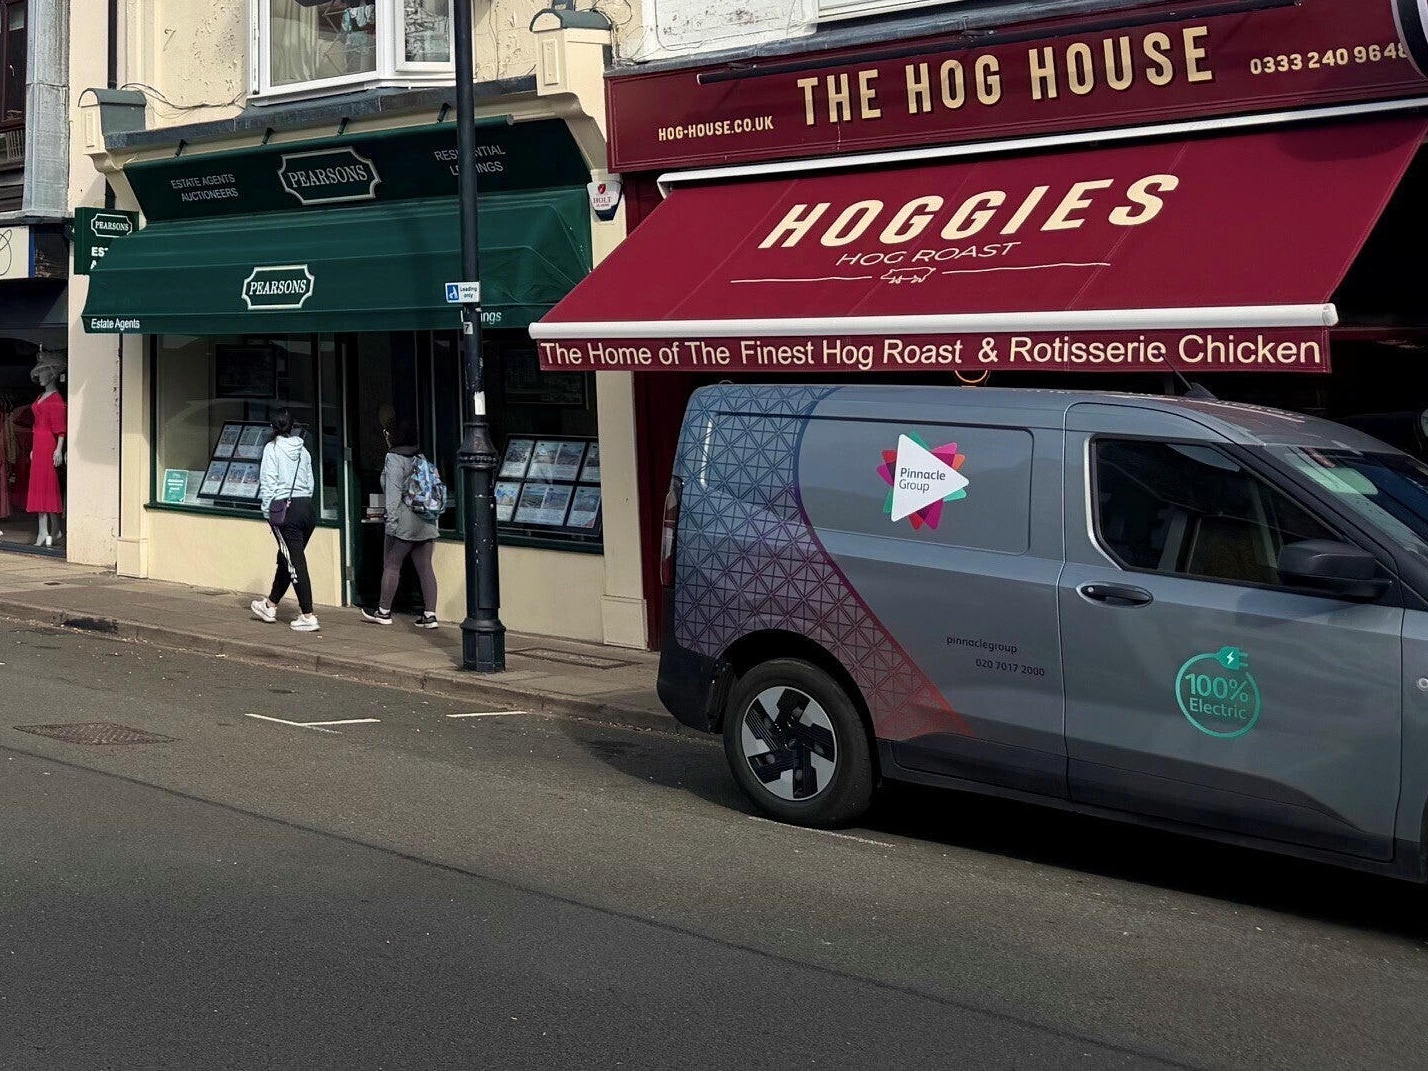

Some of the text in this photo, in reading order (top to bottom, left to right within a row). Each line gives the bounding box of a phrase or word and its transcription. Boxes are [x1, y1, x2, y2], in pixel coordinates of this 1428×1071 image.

[1250, 53, 1303, 75] 0333
[1307, 48, 1349, 69] 240
[797, 26, 1213, 126] THE HOG HOUSE
[171, 173, 236, 190] ESTATE AGENTS
[287, 164, 369, 189] PEARSONS
[181, 187, 239, 203] AUCTIONEERS
[758, 173, 1180, 250] HOGGIES
[95, 221, 129, 232] PEARSONS
[835, 241, 1022, 267] HOG ROAST
[249, 279, 307, 295] PEARSONS
[91, 318, 140, 331] Estate Agents
[540, 334, 1321, 371] The Home of The Finest Hog Roast & Rotisserie Chicken
[900, 467, 946, 481] Pinnacle
[898, 479, 930, 494] Group
[946, 635, 1018, 655] pinnaclegroup
[975, 658, 1045, 677] 020 7017 2000
[1185, 673, 1249, 703] 100%
[1189, 697, 1248, 720] Electric
